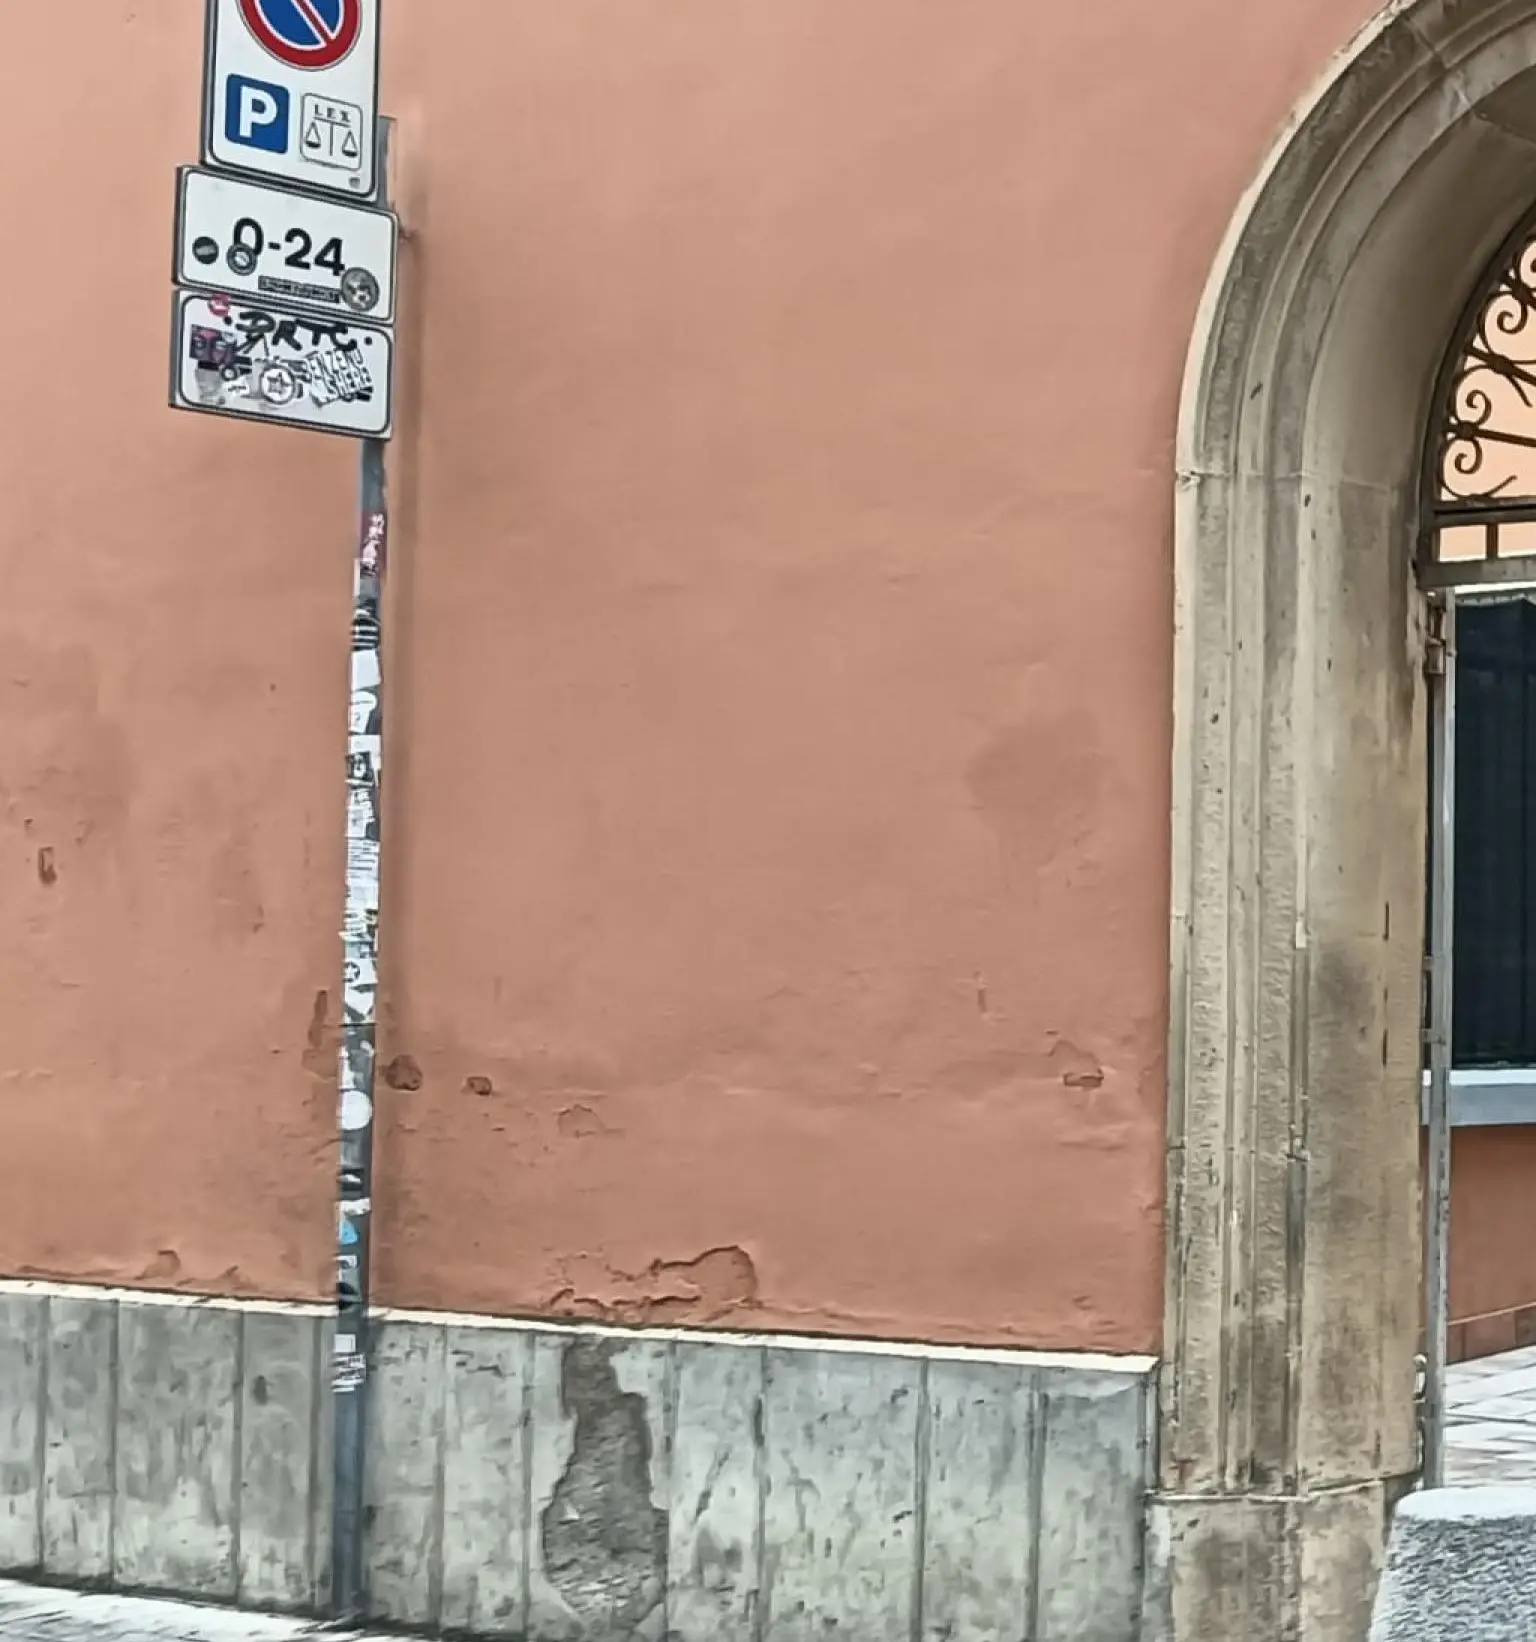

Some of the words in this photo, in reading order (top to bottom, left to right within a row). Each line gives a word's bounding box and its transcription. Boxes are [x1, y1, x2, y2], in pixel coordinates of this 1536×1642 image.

[239, 85, 278, 139] P
[314, 103, 352, 123] LEX
[232, 217, 346, 277] 0-24
